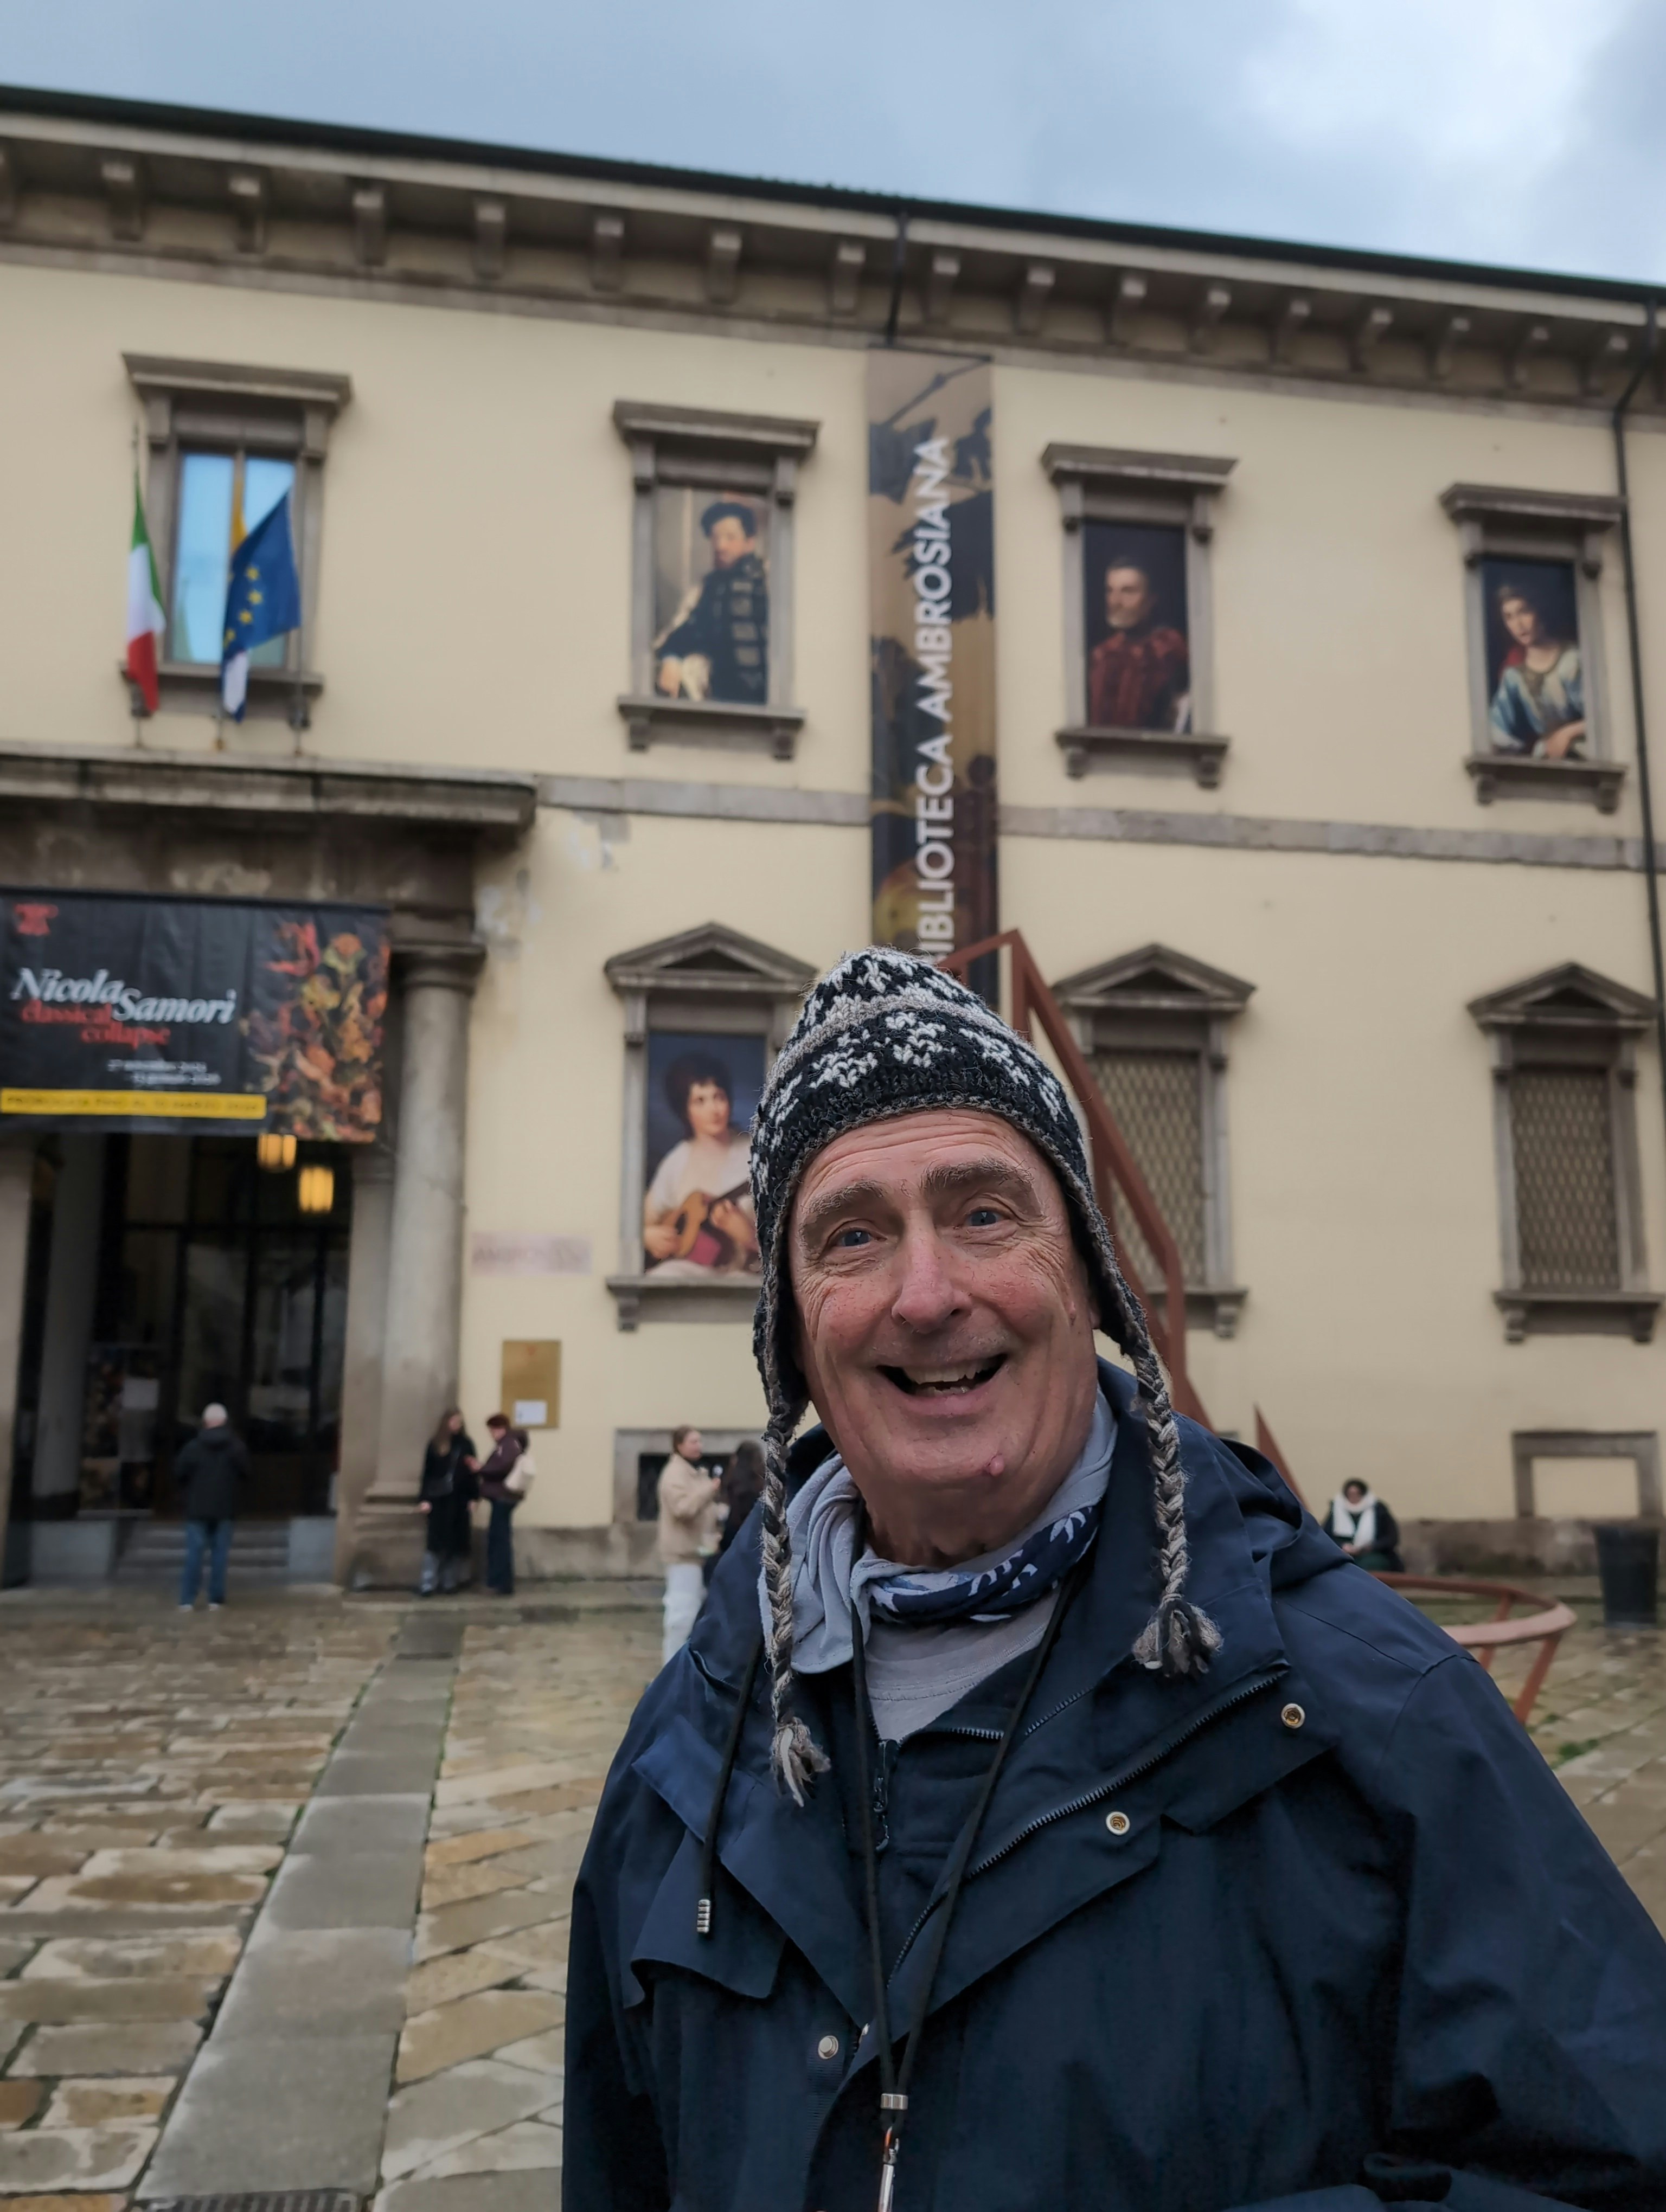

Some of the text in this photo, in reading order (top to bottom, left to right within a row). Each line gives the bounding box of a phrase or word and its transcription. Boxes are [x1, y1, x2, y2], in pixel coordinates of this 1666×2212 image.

[914, 436, 954, 963] IBLIOTECA AMBROSIANA
[11, 968, 124, 1004] Nicola
